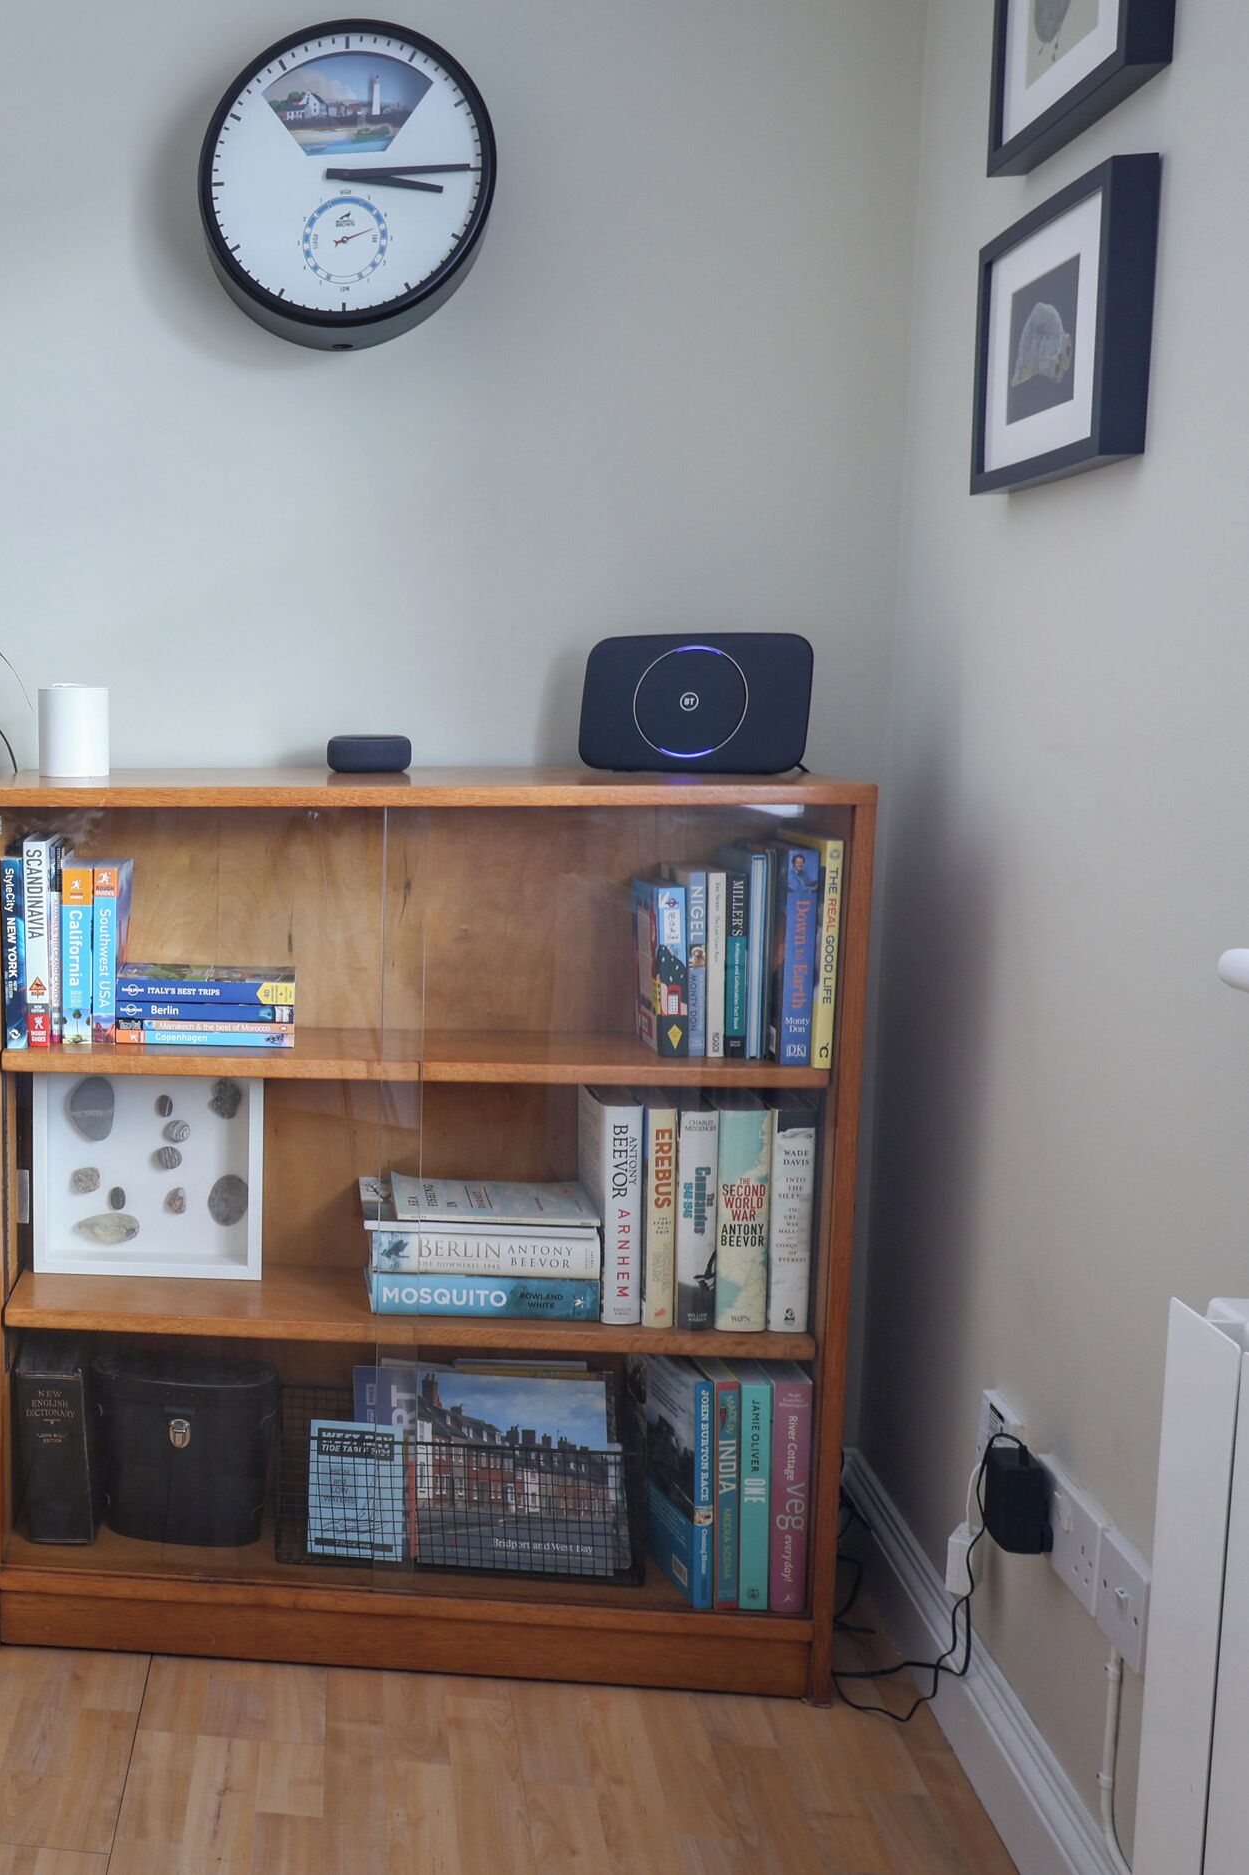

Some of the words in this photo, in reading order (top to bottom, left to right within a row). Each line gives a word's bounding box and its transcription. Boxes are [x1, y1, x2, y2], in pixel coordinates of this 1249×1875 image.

[4, 868, 15, 912] StyleCity
[26, 849, 44, 939] SCANDINAVIA
[828, 868, 838, 894] THE
[690, 886, 704, 942] NIGEL
[731, 880, 743, 936] MILLER'S
[826, 898, 837, 932] REAL
[7, 917, 17, 944] NEW
[794, 900, 811, 945] Down
[69, 910, 82, 986] California
[99, 909, 111, 976] Southwest
[796, 948, 804, 960] to
[824, 935, 835, 973] GOOD
[8, 946, 18, 978] YORK
[99, 980, 110, 1008] USA
[791, 964, 808, 1008] Earth
[823, 977, 833, 1005] LIFE
[151, 1005, 179, 1015] Berlin
[785, 1016, 810, 1026] Monty
[155, 1033, 208, 1043] Copenhagen
[789, 1024, 806, 1033] Don
[788, 1044, 806, 1057] DK
[612, 1124, 628, 1199] BEEVOR
[628, 1136, 637, 1186] ANTONY
[655, 1129, 673, 1209] EREBUS
[694, 1167, 711, 1234] Commandos
[722, 1184, 766, 1197] SECOND
[724, 1197, 763, 1209] WORLD
[721, 1223, 764, 1236] ANTONY
[732, 1209, 756, 1222] WAR
[419, 1237, 501, 1259] BERLIN
[507, 1244, 573, 1257] ANTONY
[616, 1209, 631, 1297] ARNHEM
[721, 1235, 764, 1247] BEEVOR
[511, 1257, 571, 1269] BEEVOR
[383, 1286, 507, 1308] MOSQUITO
[519, 1292, 563, 1301] ROWLAND
[527, 1301, 555, 1309] WHITE
[26, 1409, 75, 1418] DICTIONARY
[31, 1400, 68, 1408] ENGLISH
[700, 1390, 708, 1421] JOHN
[726, 1396, 737, 1422] MADE
[751, 1400, 760, 1431] JAMIE
[788, 1416, 798, 1440] River
[322, 1444, 341, 1452] TIDE
[343, 1445, 369, 1453] TABLE
[700, 1423, 709, 1467] BURTON
[750, 1434, 760, 1472] OLIVER
[719, 1439, 737, 1495] INDIA
[785, 1443, 797, 1480] Cottage
[700, 1469, 709, 1501] RACE
[744, 1479, 766, 1503] ONE
[723, 1508, 731, 1543] MEERA
[493, 1538, 530, 1550] Bridport
[533, 1542, 550, 1550] and
[552, 1543, 573, 1552] West
[576, 1544, 593, 1555] Bay
[722, 1544, 731, 1579] SODHA
